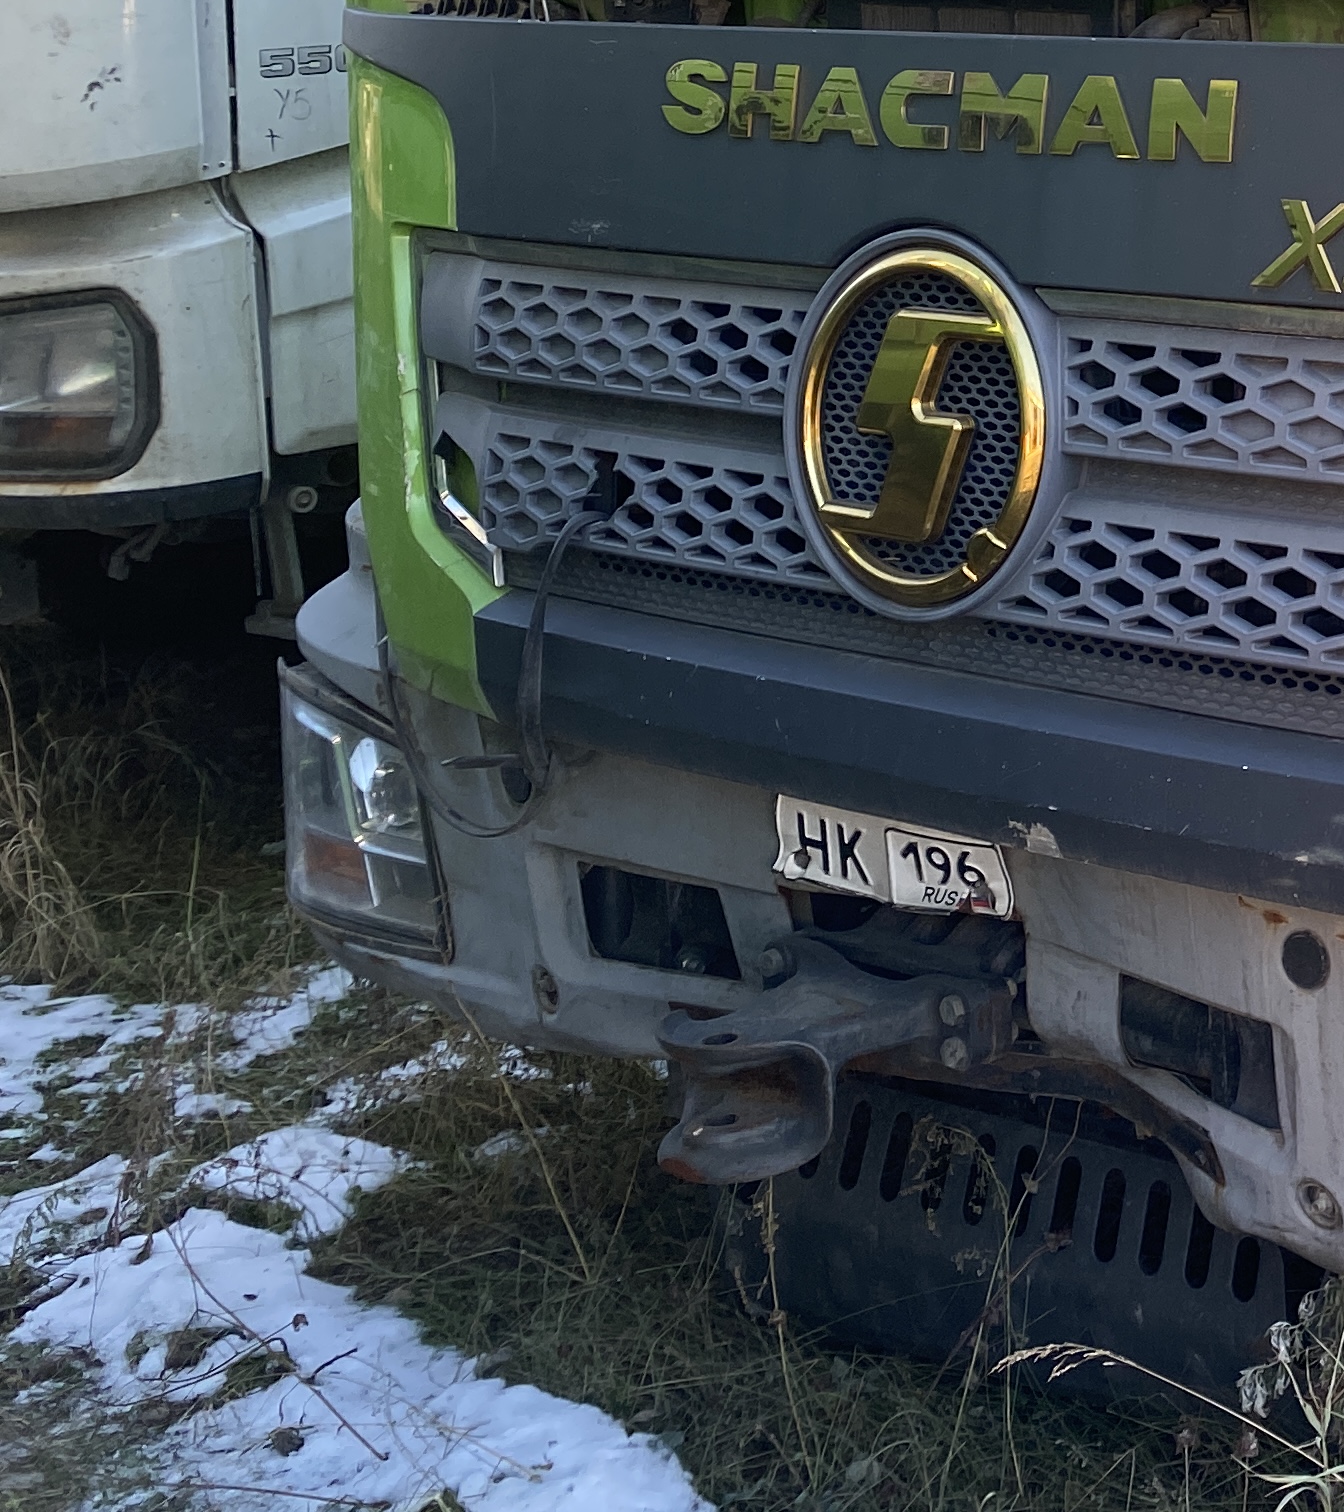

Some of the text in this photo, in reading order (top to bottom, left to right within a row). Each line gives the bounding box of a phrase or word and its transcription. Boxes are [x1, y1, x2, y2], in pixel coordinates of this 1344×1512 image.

[660, 58, 1240, 163] SHACMAN
[900, 840, 987, 888] 196
[921, 885, 959, 907] RUS
